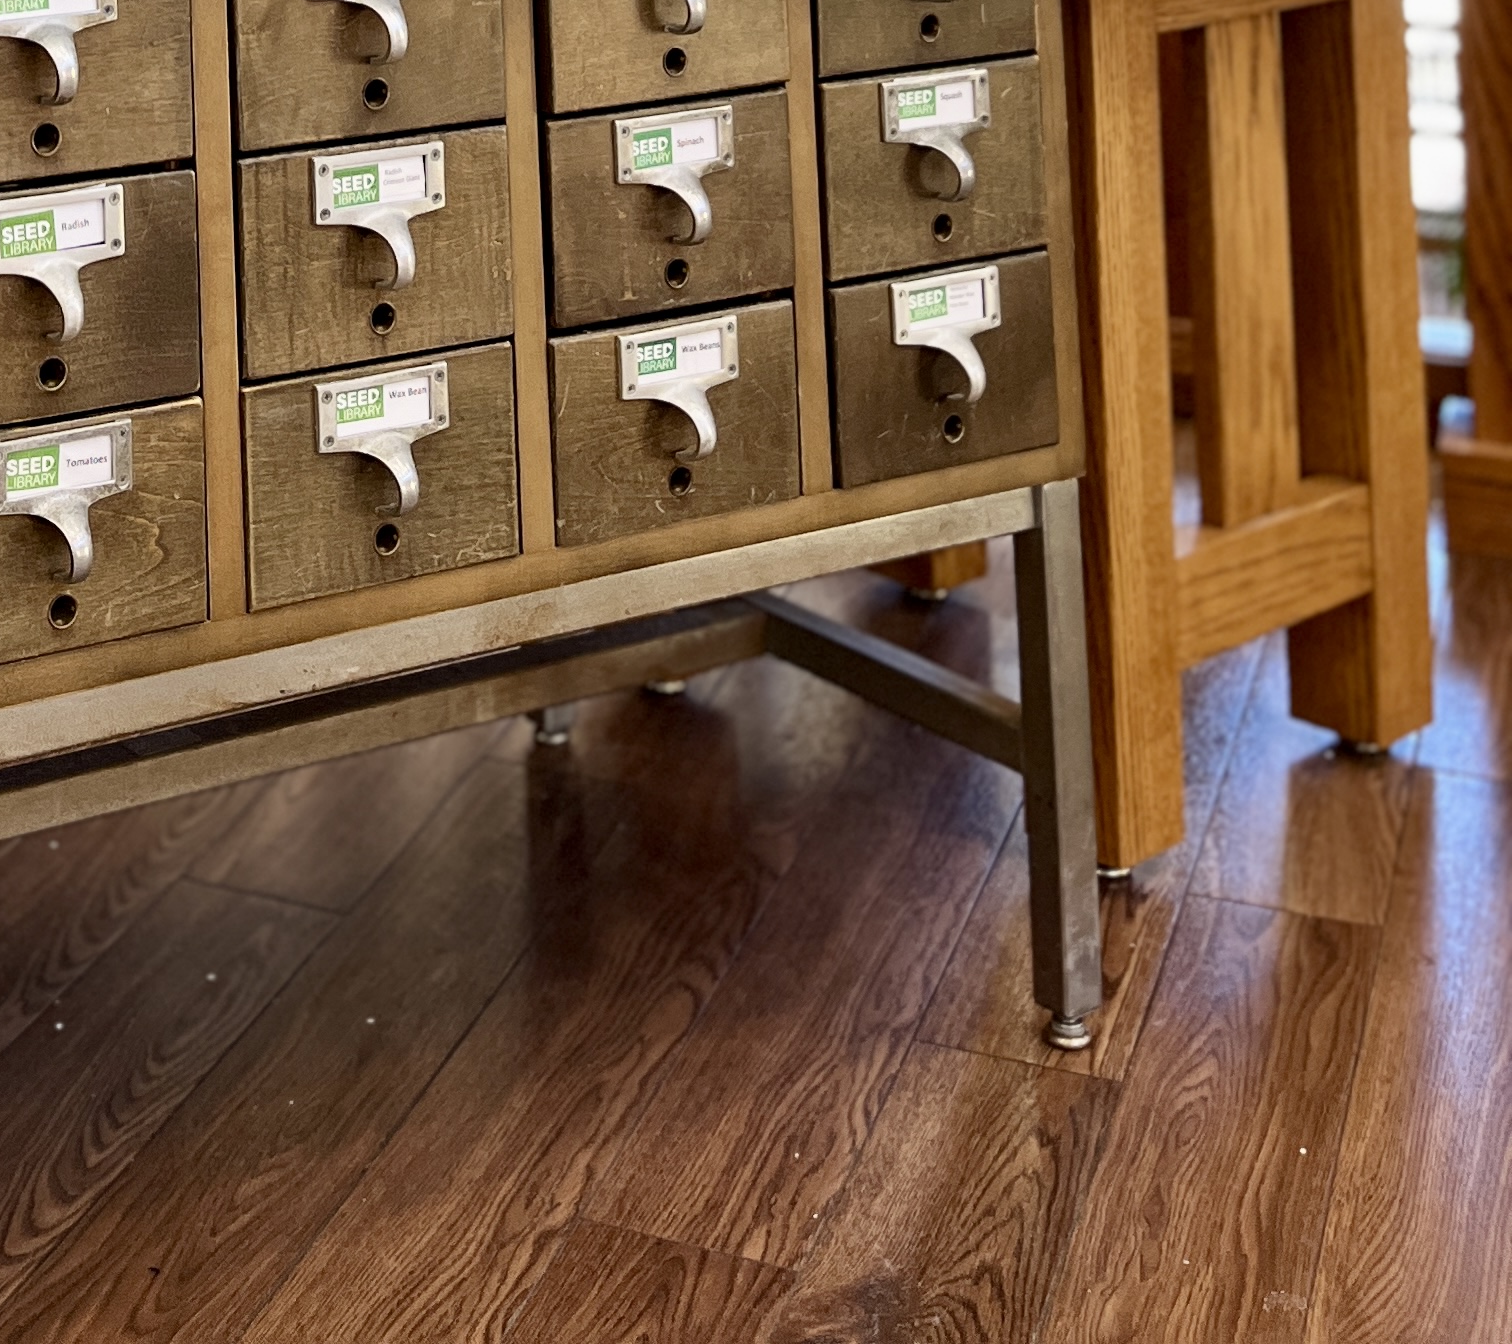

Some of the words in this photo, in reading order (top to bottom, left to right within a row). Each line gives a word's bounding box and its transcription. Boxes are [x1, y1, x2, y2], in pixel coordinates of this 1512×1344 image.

[898, 89, 932, 106] SEED
[940, 91, 962, 101] Squash
[633, 136, 668, 155] SEED
[677, 136, 704, 148] Spinach
[333, 173, 375, 193] SEED
[2, 220, 50, 242] SEED
[62, 219, 89, 231] Radish
[3, 236, 54, 256] LIBRARY
[909, 289, 943, 310] SEED
[637, 342, 673, 363] SEED
[681, 345, 697, 353] Wax
[336, 387, 380, 410] SEED
[389, 390, 406, 399] Wax
[408, 388, 427, 397] Bean
[337, 404, 382, 422] LIBRARY
[6, 456, 54, 476] SEED
[66, 455, 107, 467] Tomatoes
[7, 470, 56, 491] LIBRARY
